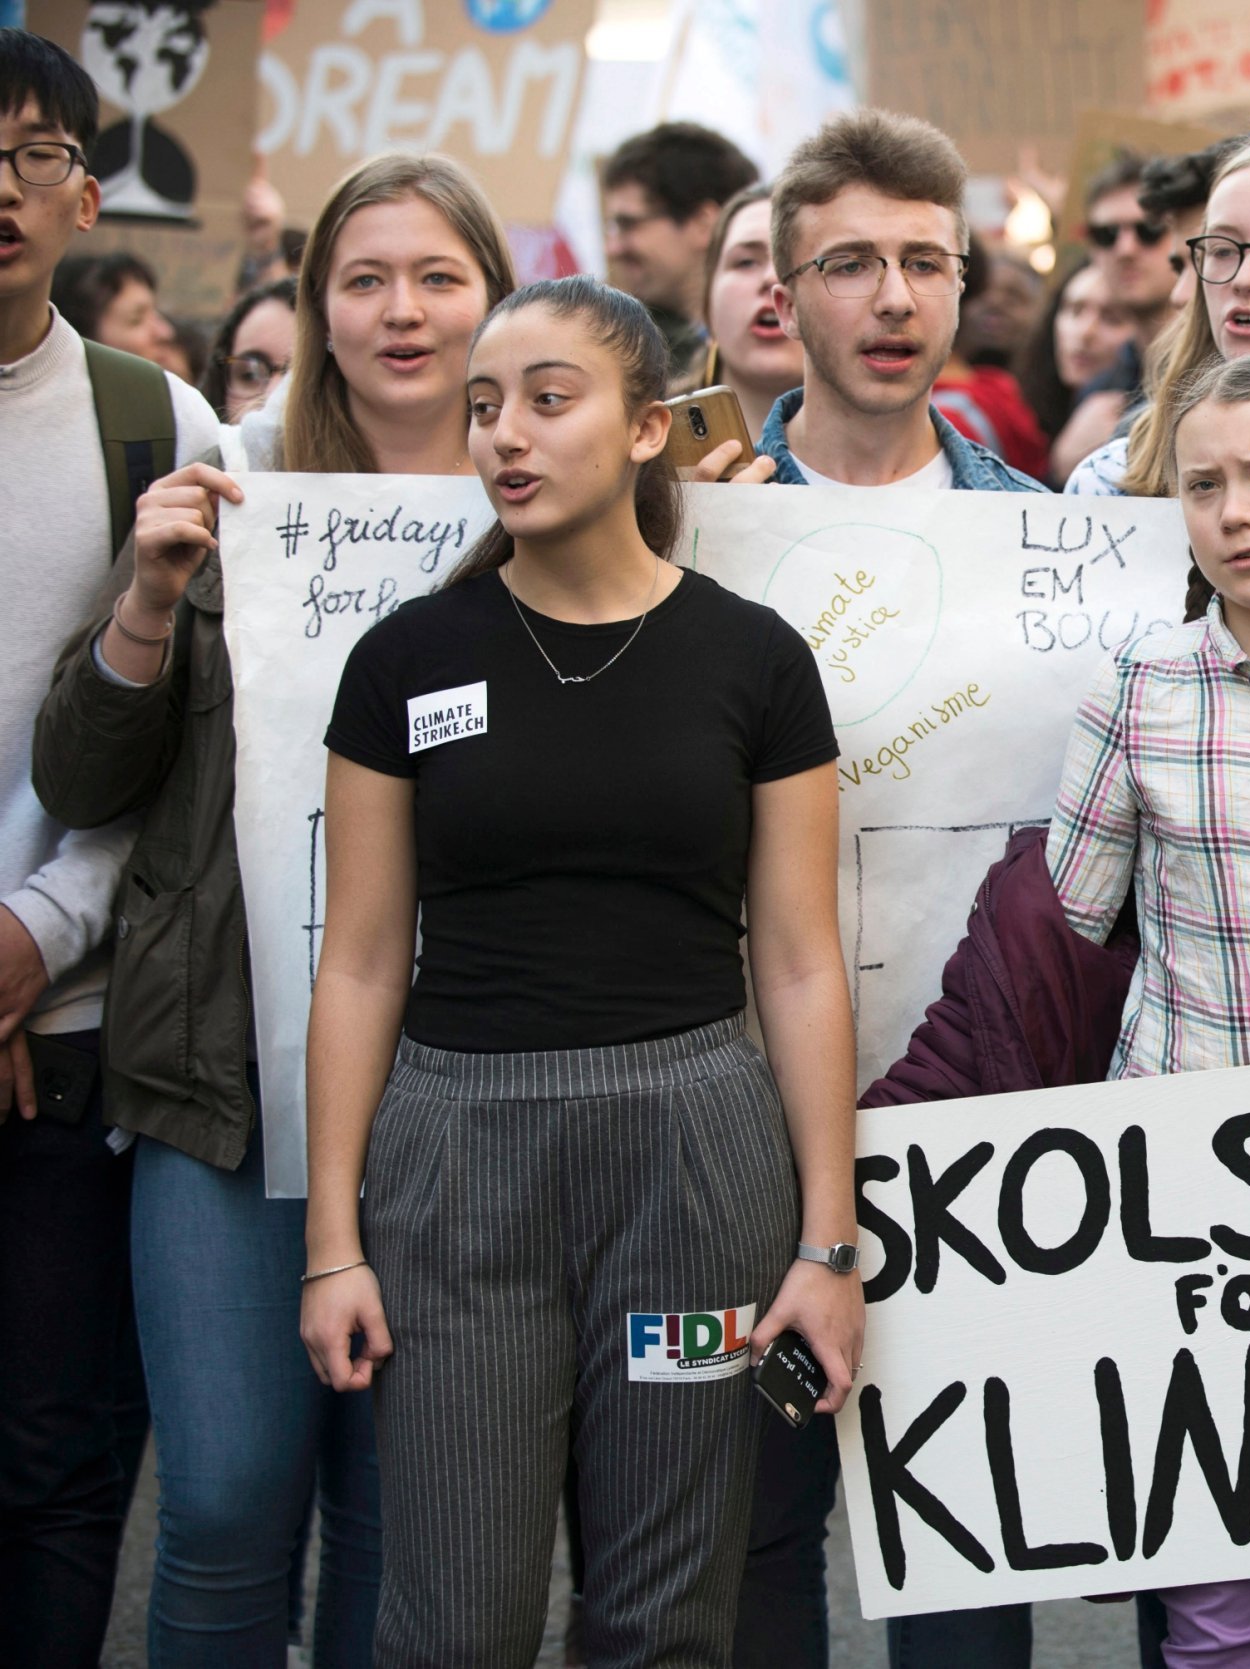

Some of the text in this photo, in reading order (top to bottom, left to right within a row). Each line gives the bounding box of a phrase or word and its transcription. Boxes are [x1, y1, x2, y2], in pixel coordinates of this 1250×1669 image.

[1021, 509, 1137, 568] LUX
[1021, 563, 1084, 605] EM
[413, 703, 472, 732] CLIMATE
[413, 716, 484, 748] STRIKE.CH
[680, 1360, 690, 1369] LE
[691, 1353, 729, 1367] SYNDICAT
[777, 1351, 796, 1371] play
[792, 1346, 816, 1374] stupid
